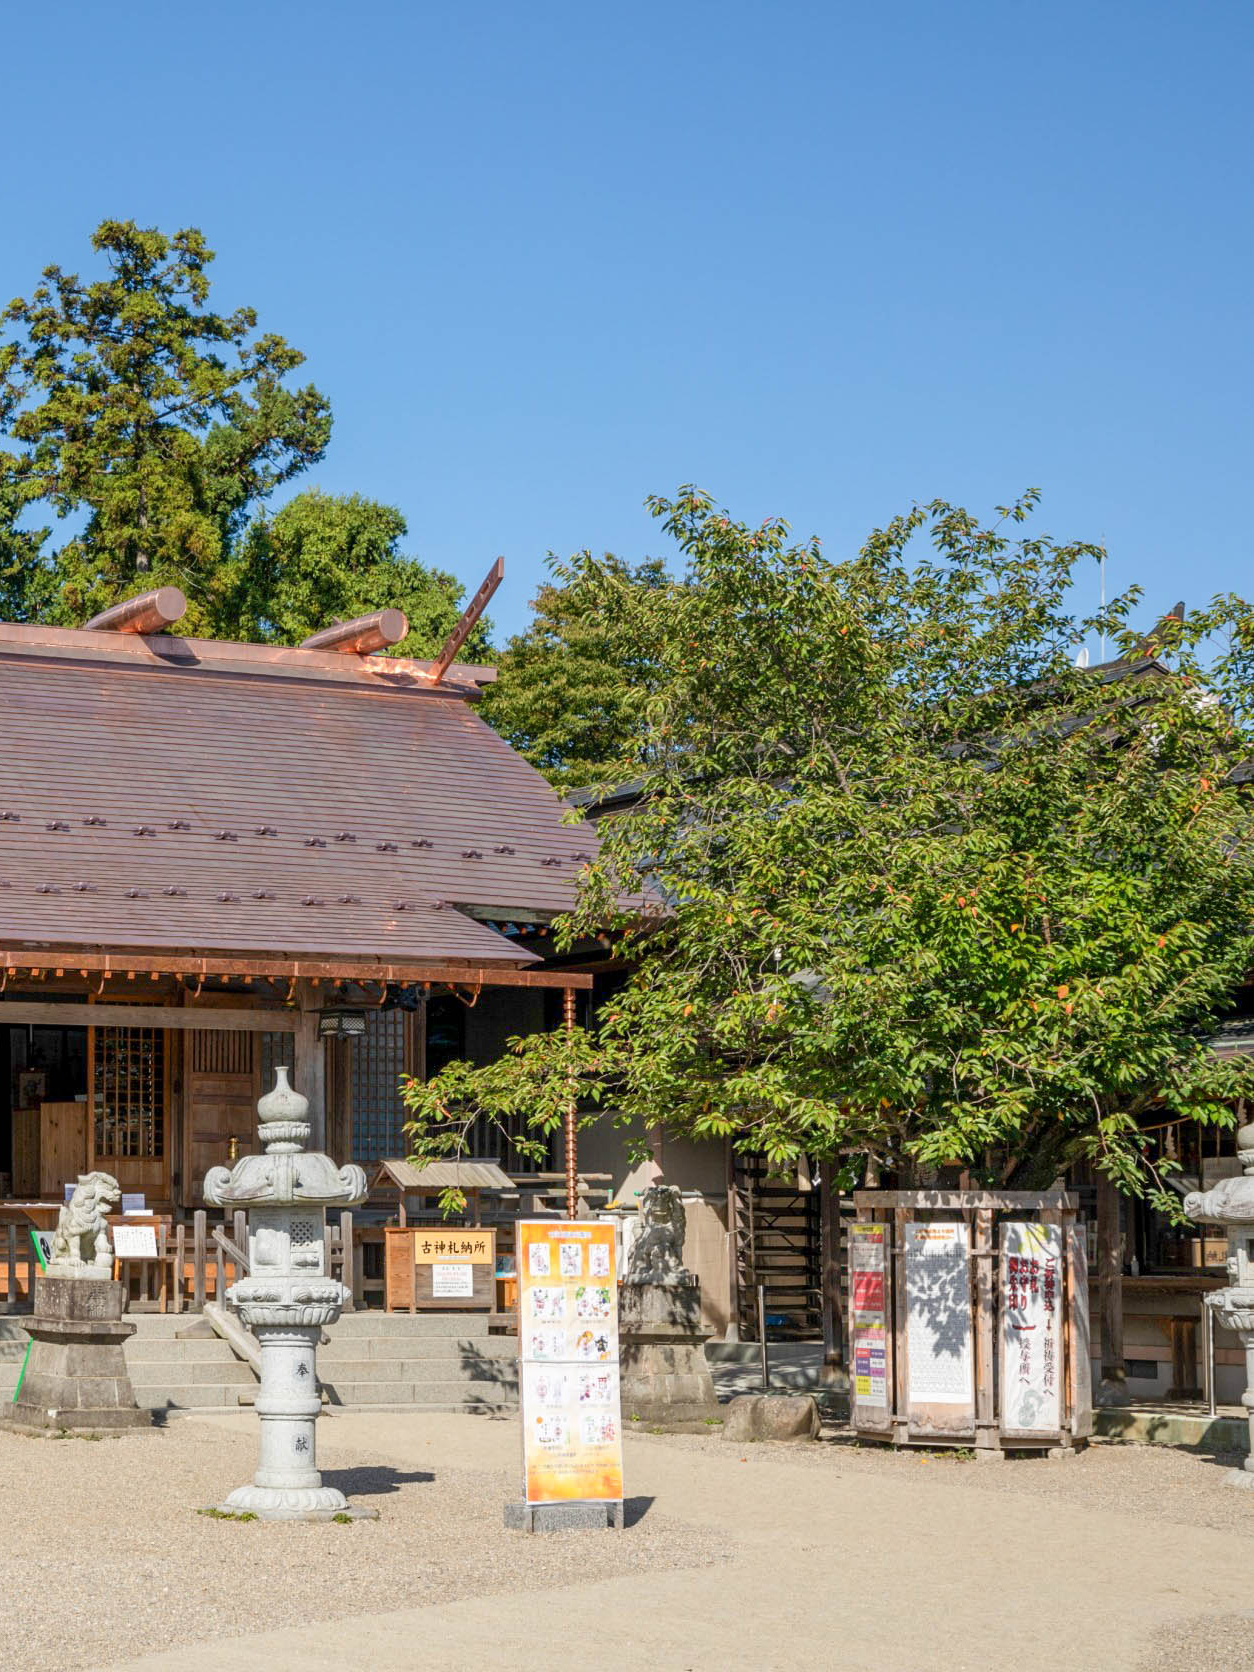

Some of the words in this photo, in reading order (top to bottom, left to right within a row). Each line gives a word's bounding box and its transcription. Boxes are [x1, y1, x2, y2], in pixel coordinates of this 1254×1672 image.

[421, 1240, 486, 1255] 古神札納所
[1019, 1257, 1029, 1311] お守り
[1029, 1257, 1039, 1293] お札
